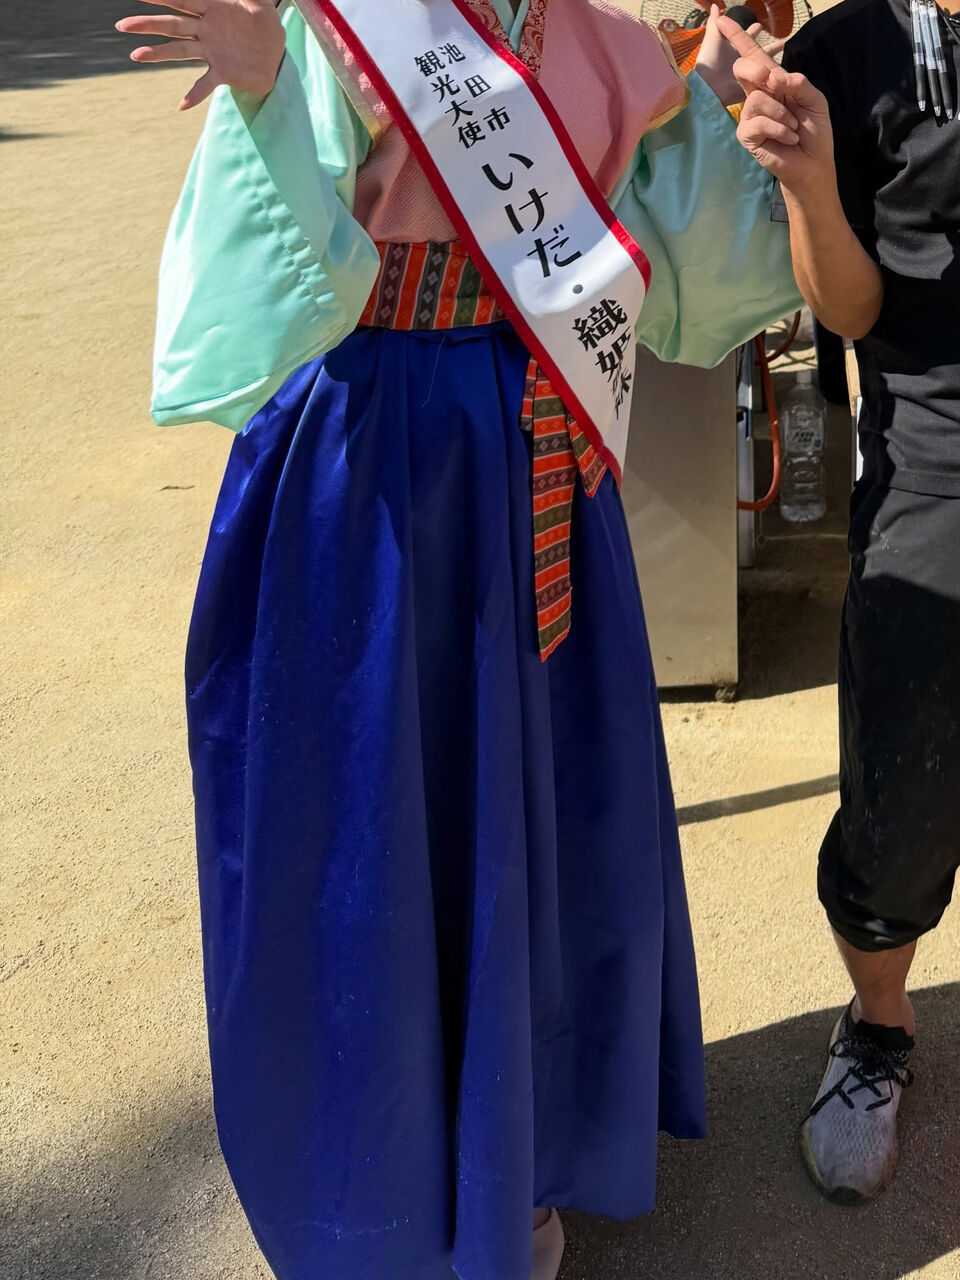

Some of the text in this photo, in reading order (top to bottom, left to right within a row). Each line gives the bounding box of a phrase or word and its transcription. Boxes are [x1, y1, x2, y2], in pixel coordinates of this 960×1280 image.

[413, 50, 487, 150] 観光大使
[437, 42, 511, 133] 池田市
